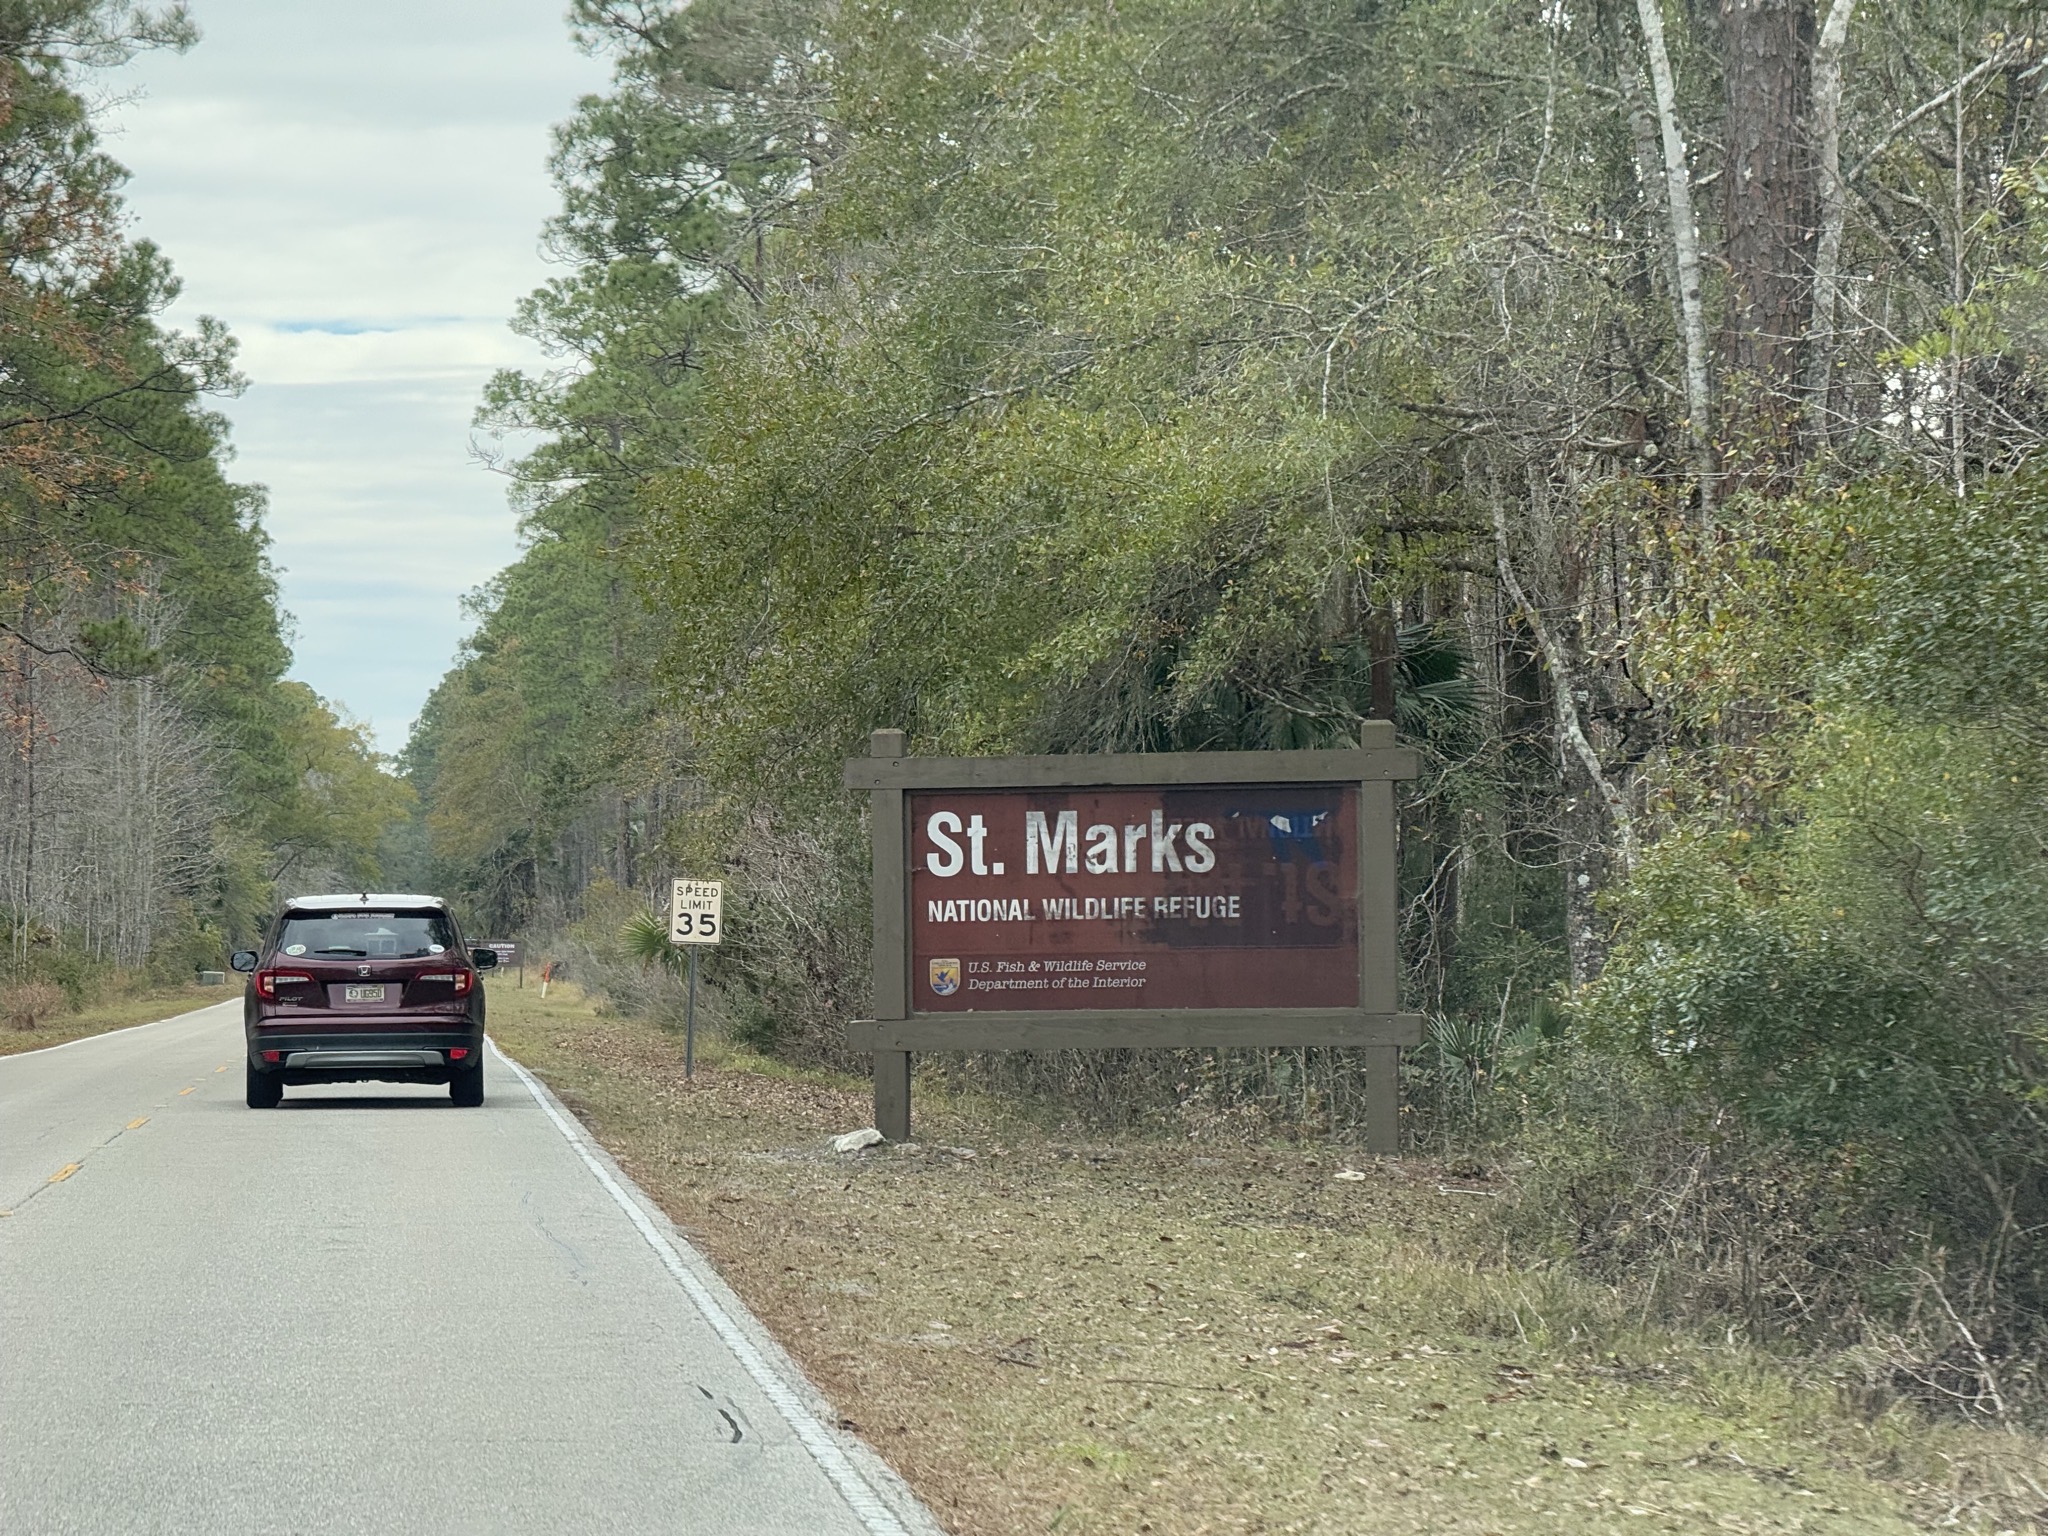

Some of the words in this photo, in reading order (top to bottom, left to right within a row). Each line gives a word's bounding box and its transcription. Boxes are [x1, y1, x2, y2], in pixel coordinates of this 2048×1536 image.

[926, 811, 1005, 877] St.
[1025, 809, 1216, 875] Marks
[676, 886, 719, 898] SPEED
[680, 899, 713, 910] LIMIT
[928, 898, 1036, 923] NATIONAL
[1042, 897, 1147, 921] WILDLIFE
[1153, 895, 1241, 920] REFUGE
[675, 912, 717, 937] 35
[967, 961, 993, 974] U.S.
[996, 960, 1025, 973] Fish
[1028, 960, 1041, 972] &
[1043, 960, 1094, 972] Wildlife
[1096, 959, 1147, 971] Service
[967, 978, 1050, 992] Department
[1051, 977, 1068, 989] of
[1068, 976, 1090, 988] the
[1092, 976, 1147, 988] Interior
